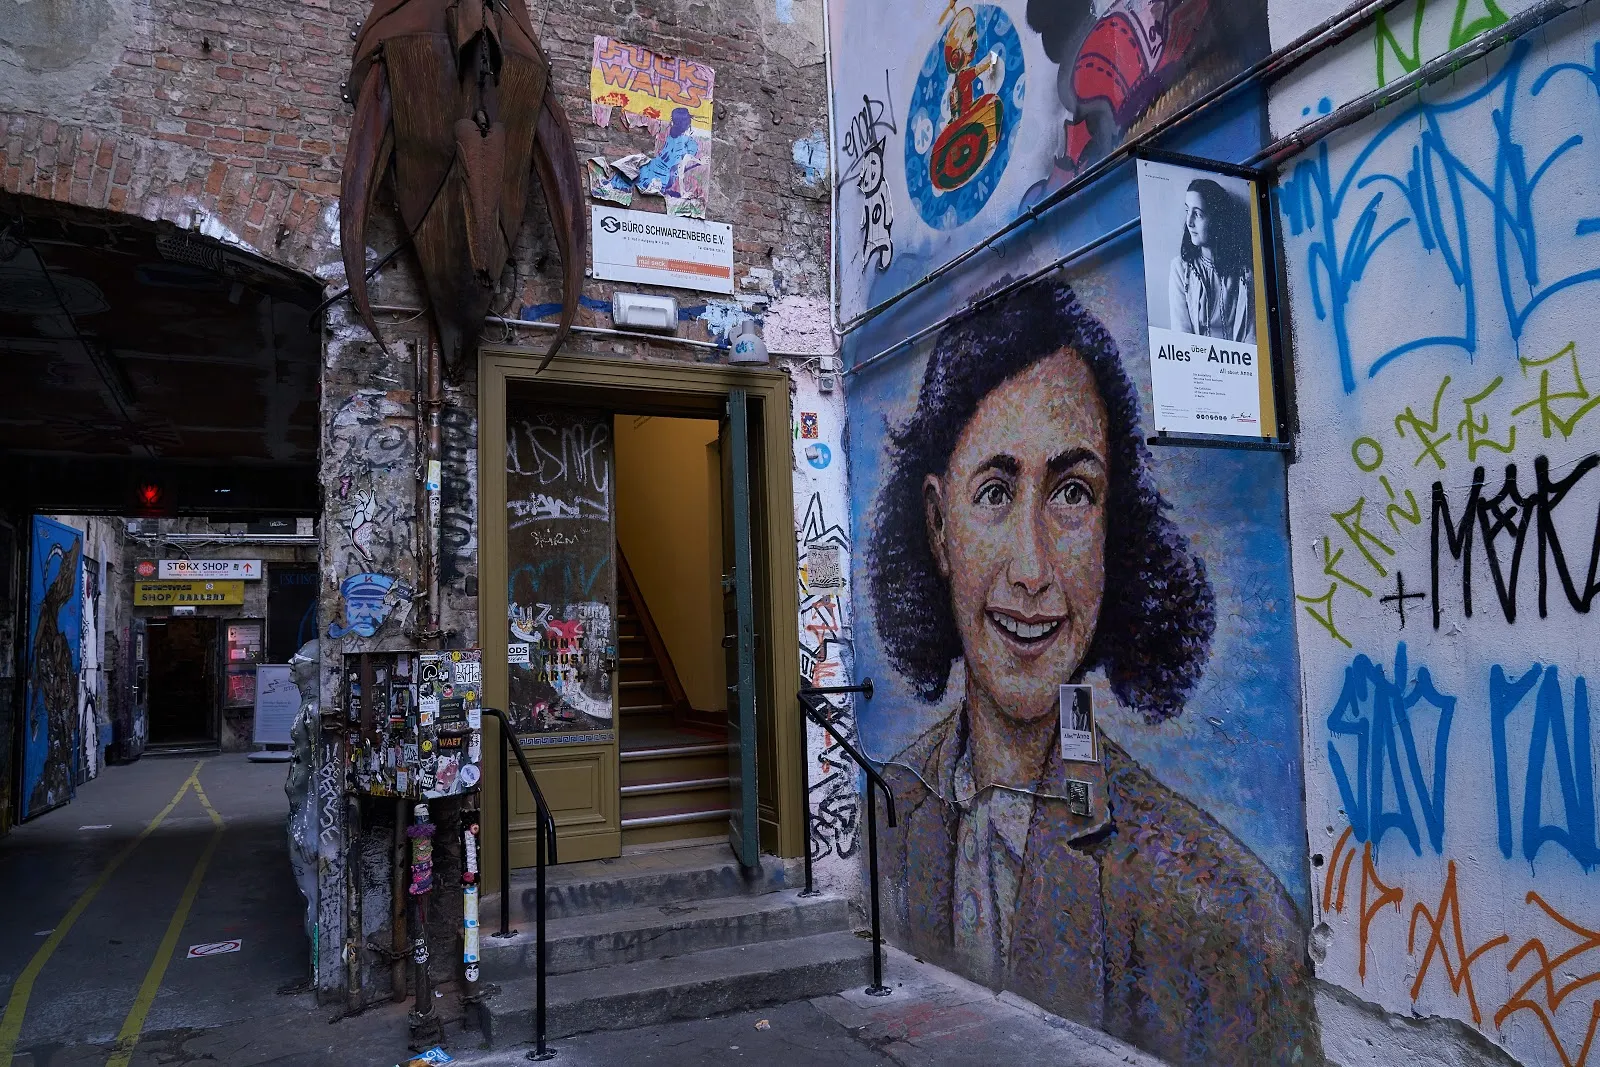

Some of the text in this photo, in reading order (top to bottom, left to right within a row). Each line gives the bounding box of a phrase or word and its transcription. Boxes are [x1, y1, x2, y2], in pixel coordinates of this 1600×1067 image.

[600, 40, 702, 81] FUCK
[600, 60, 707, 108] WARS
[622, 220, 644, 234] BÜRO
[646, 226, 711, 243] SCHWARZENBERG
[713, 234, 725, 245] E.V.
[1158, 344, 1252, 366] Alles über Anne
[167, 562, 229, 571] STOKX SHOP
[540, 654, 589, 666] TRUST
